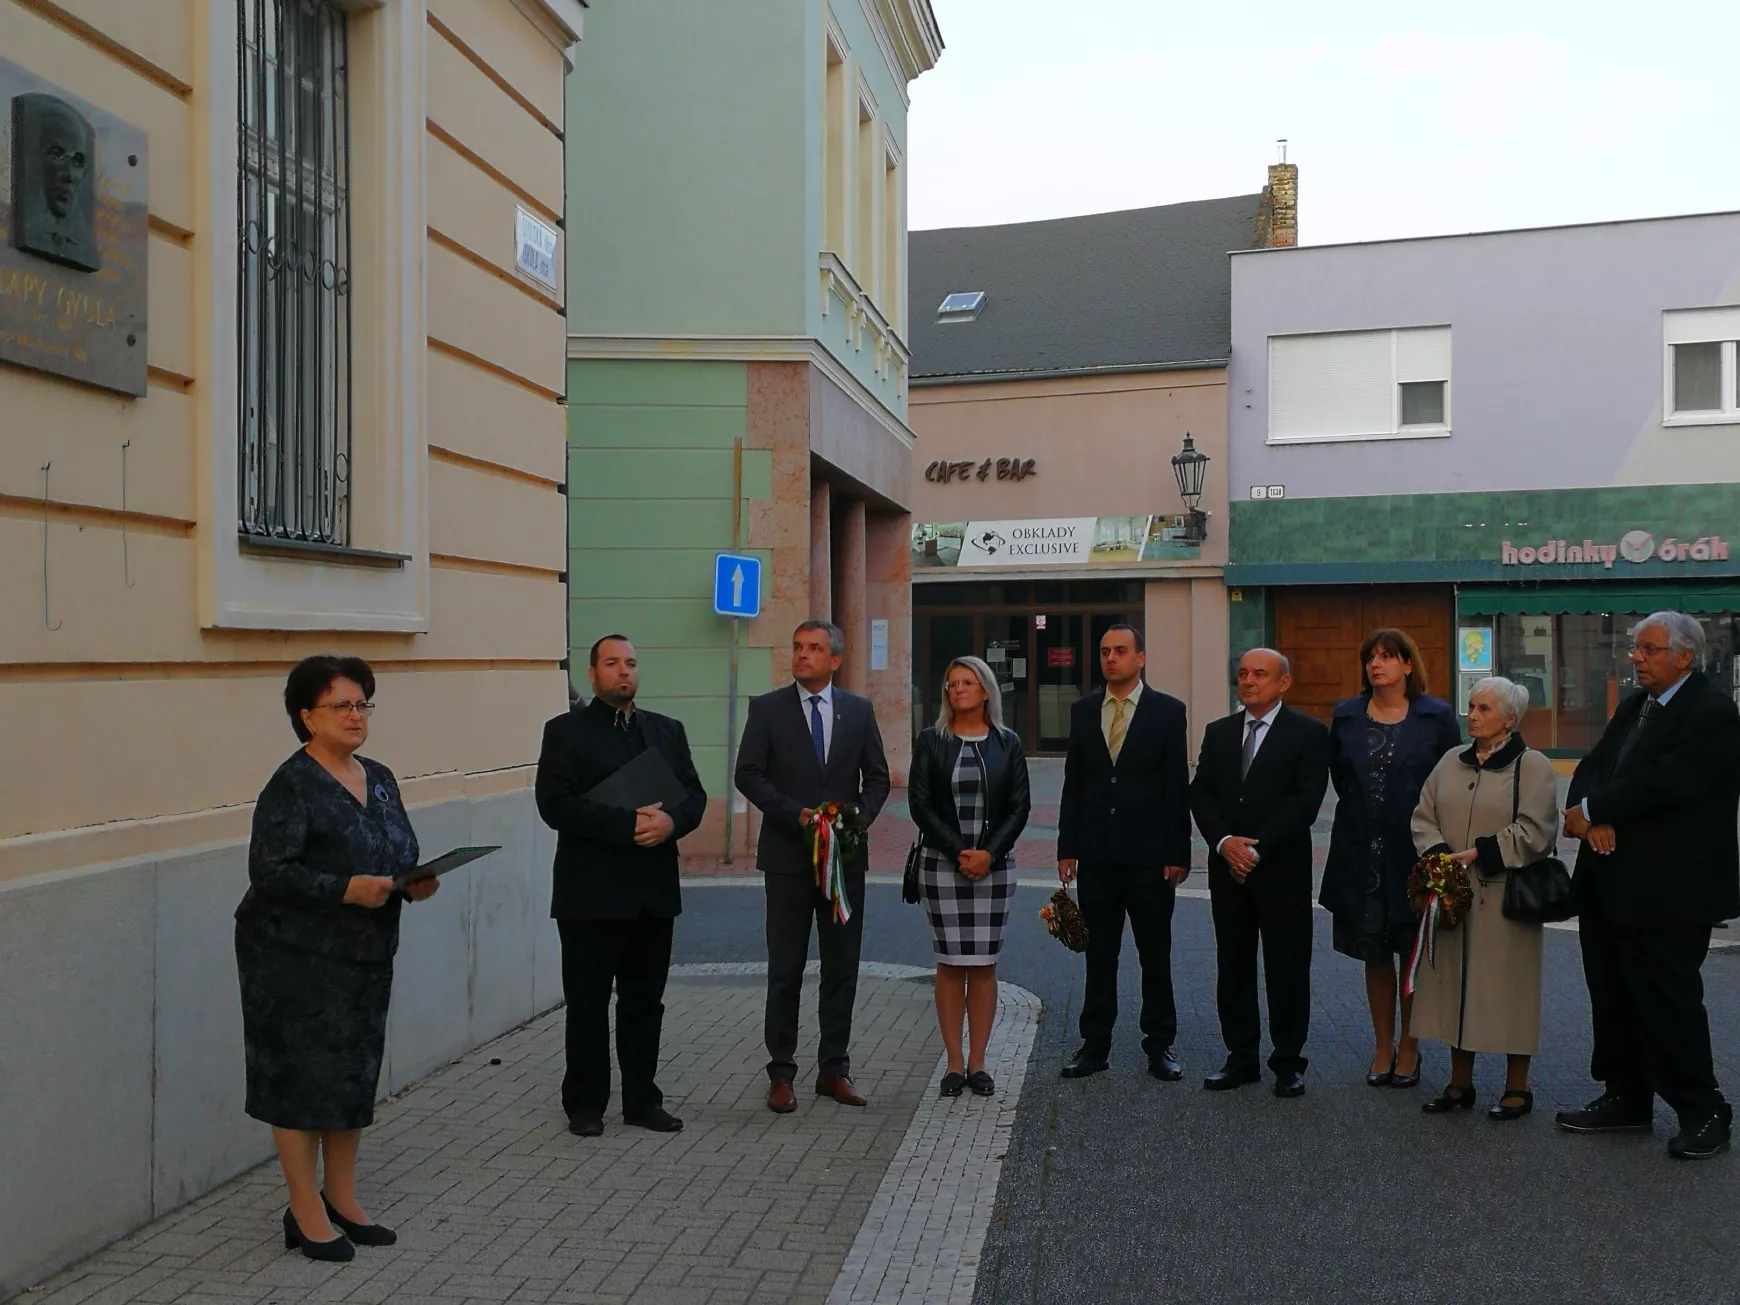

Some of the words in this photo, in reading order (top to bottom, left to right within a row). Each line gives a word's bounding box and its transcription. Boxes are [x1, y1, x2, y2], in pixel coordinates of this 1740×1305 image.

[924, 460, 975, 484] CAFE
[976, 457, 992, 482] &
[996, 457, 1036, 482] BAR
[1012, 526, 1076, 540] OBKLADY
[1009, 541, 1080, 556] EXCLUSIVE
[1501, 539, 1617, 569] hodinky
[1657, 536, 1729, 563] órák
